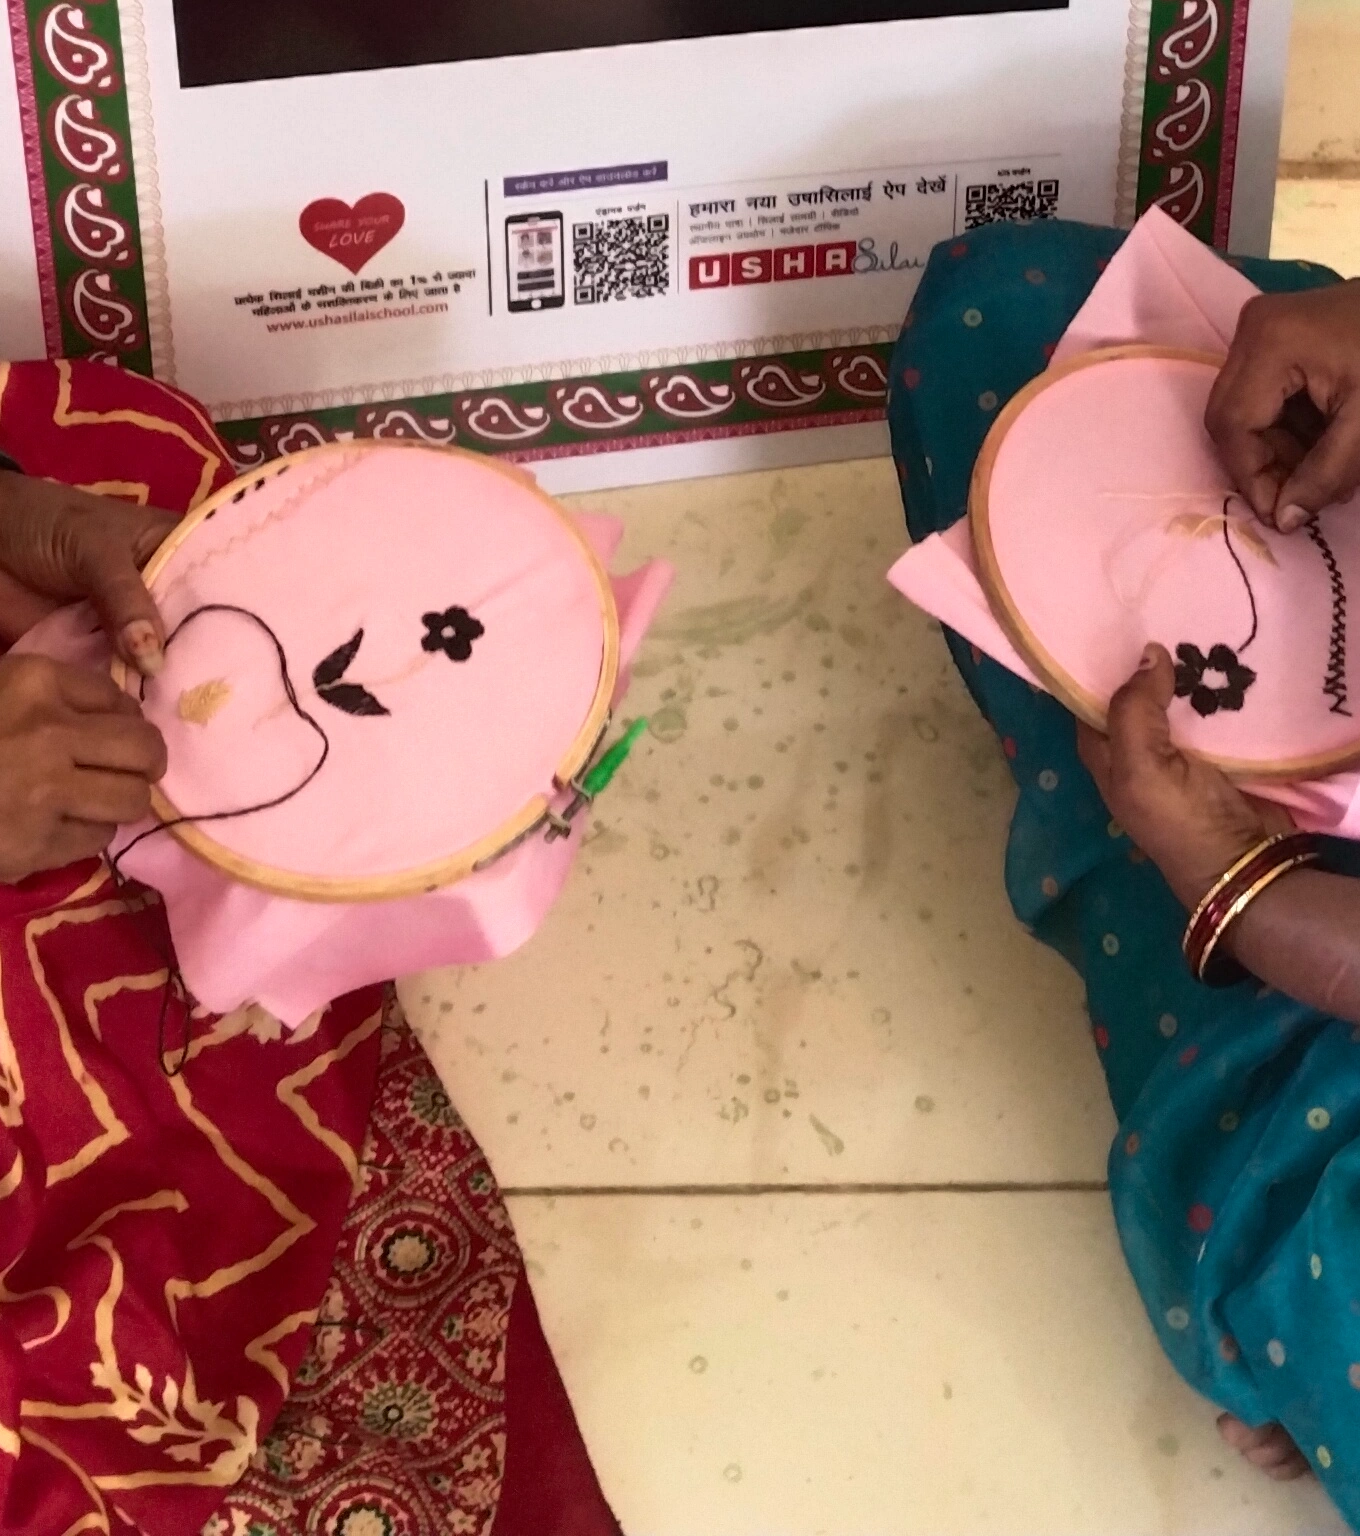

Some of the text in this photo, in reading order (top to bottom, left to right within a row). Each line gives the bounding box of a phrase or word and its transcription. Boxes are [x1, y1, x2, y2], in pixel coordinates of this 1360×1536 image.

[688, 174, 947, 218] हमारा नया उषासिलाई ऐप देखें
[328, 229, 376, 249] LOVE
[409, 274, 427, 286] 1%
[697, 247, 848, 285] USHA
[266, 301, 450, 333] www.ushasilaischool.com
